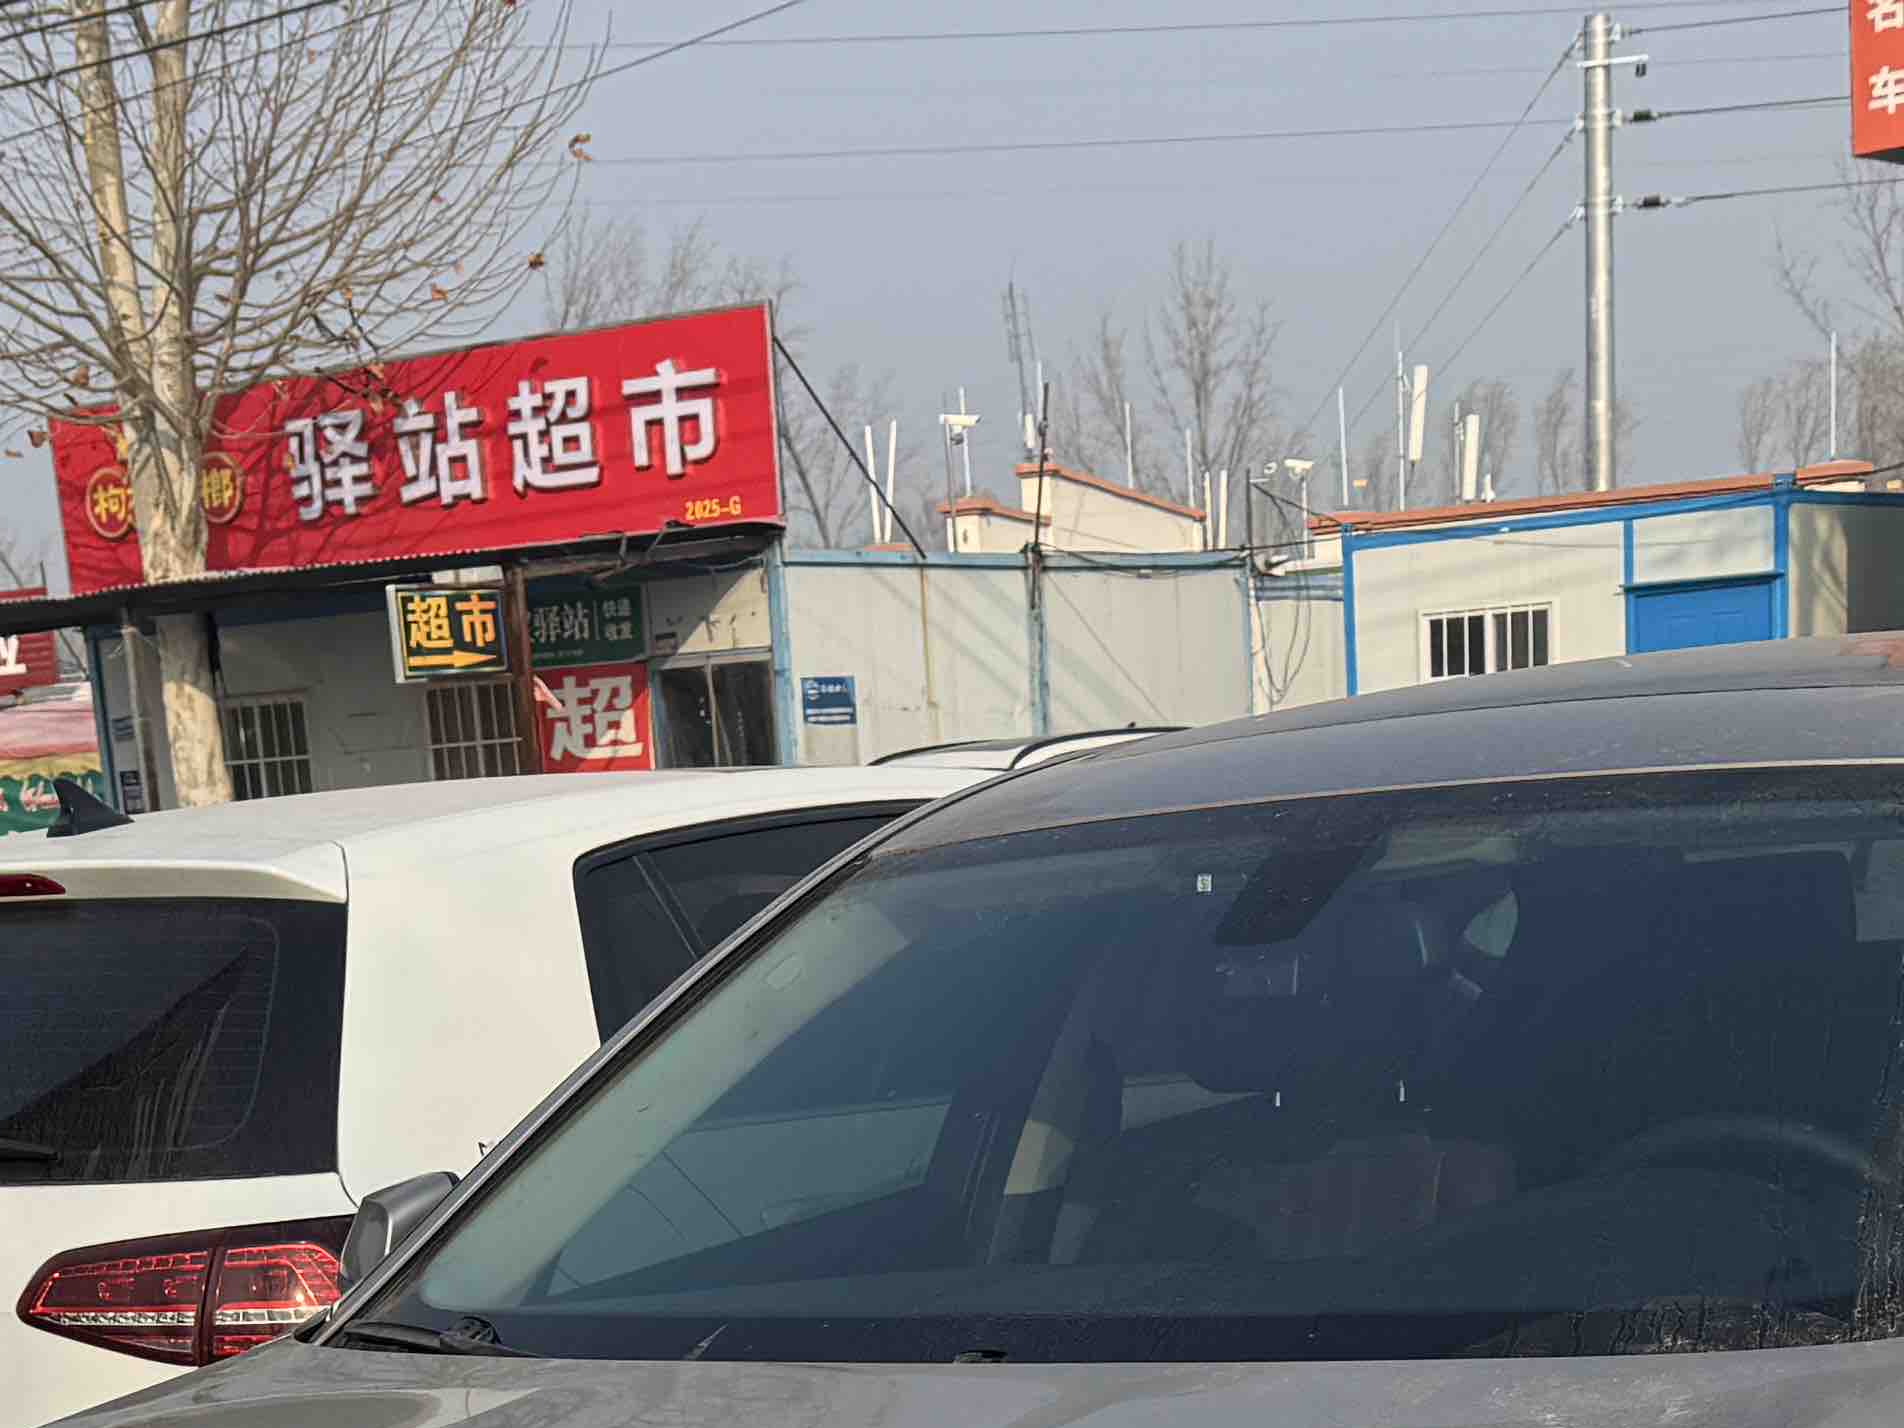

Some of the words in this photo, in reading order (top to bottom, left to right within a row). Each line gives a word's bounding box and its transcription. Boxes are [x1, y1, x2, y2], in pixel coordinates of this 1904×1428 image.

[284, 360, 718, 520] 驿站超市
[406, 592, 497, 649] 超市
[547, 674, 644, 761] 超
